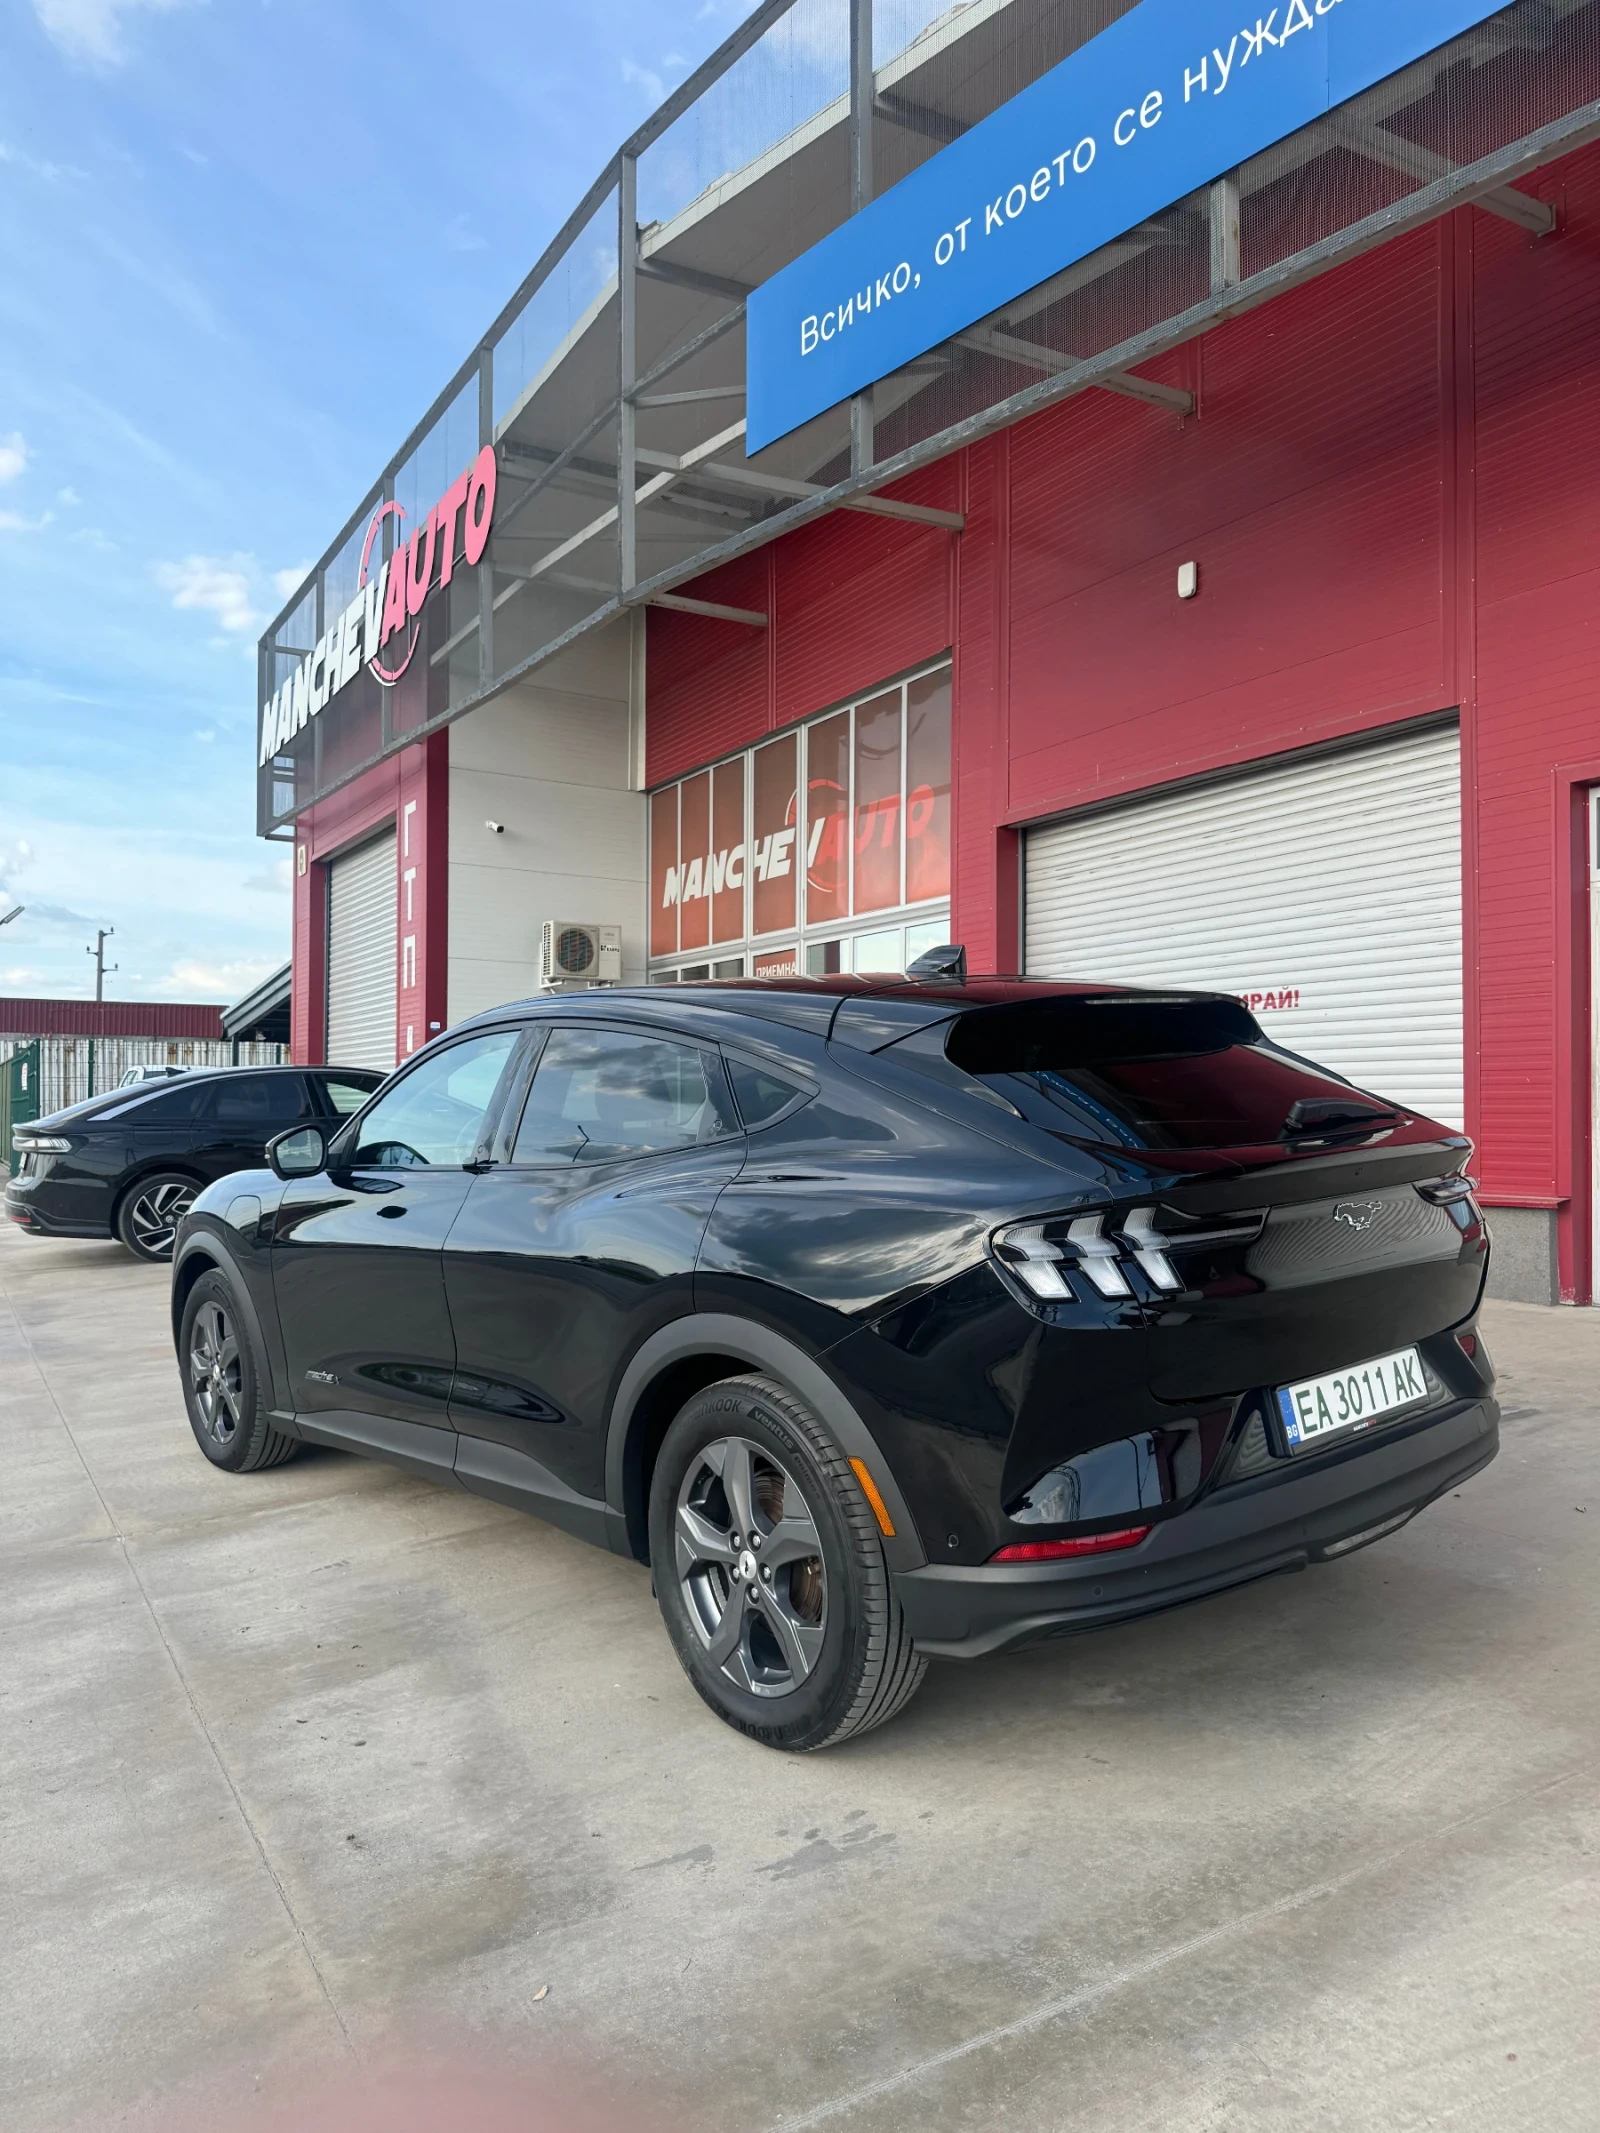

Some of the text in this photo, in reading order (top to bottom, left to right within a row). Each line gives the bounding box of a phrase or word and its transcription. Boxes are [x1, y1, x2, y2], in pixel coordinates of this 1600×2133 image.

[801, 262, 921, 356] Всичко,
[934, 217, 971, 265] от
[984, 137, 1096, 235] което
[1113, 91, 1163, 146] се
[1286, 1425, 1299, 1439] BG
[1296, 1355, 1423, 1434] EA 3011 AK
